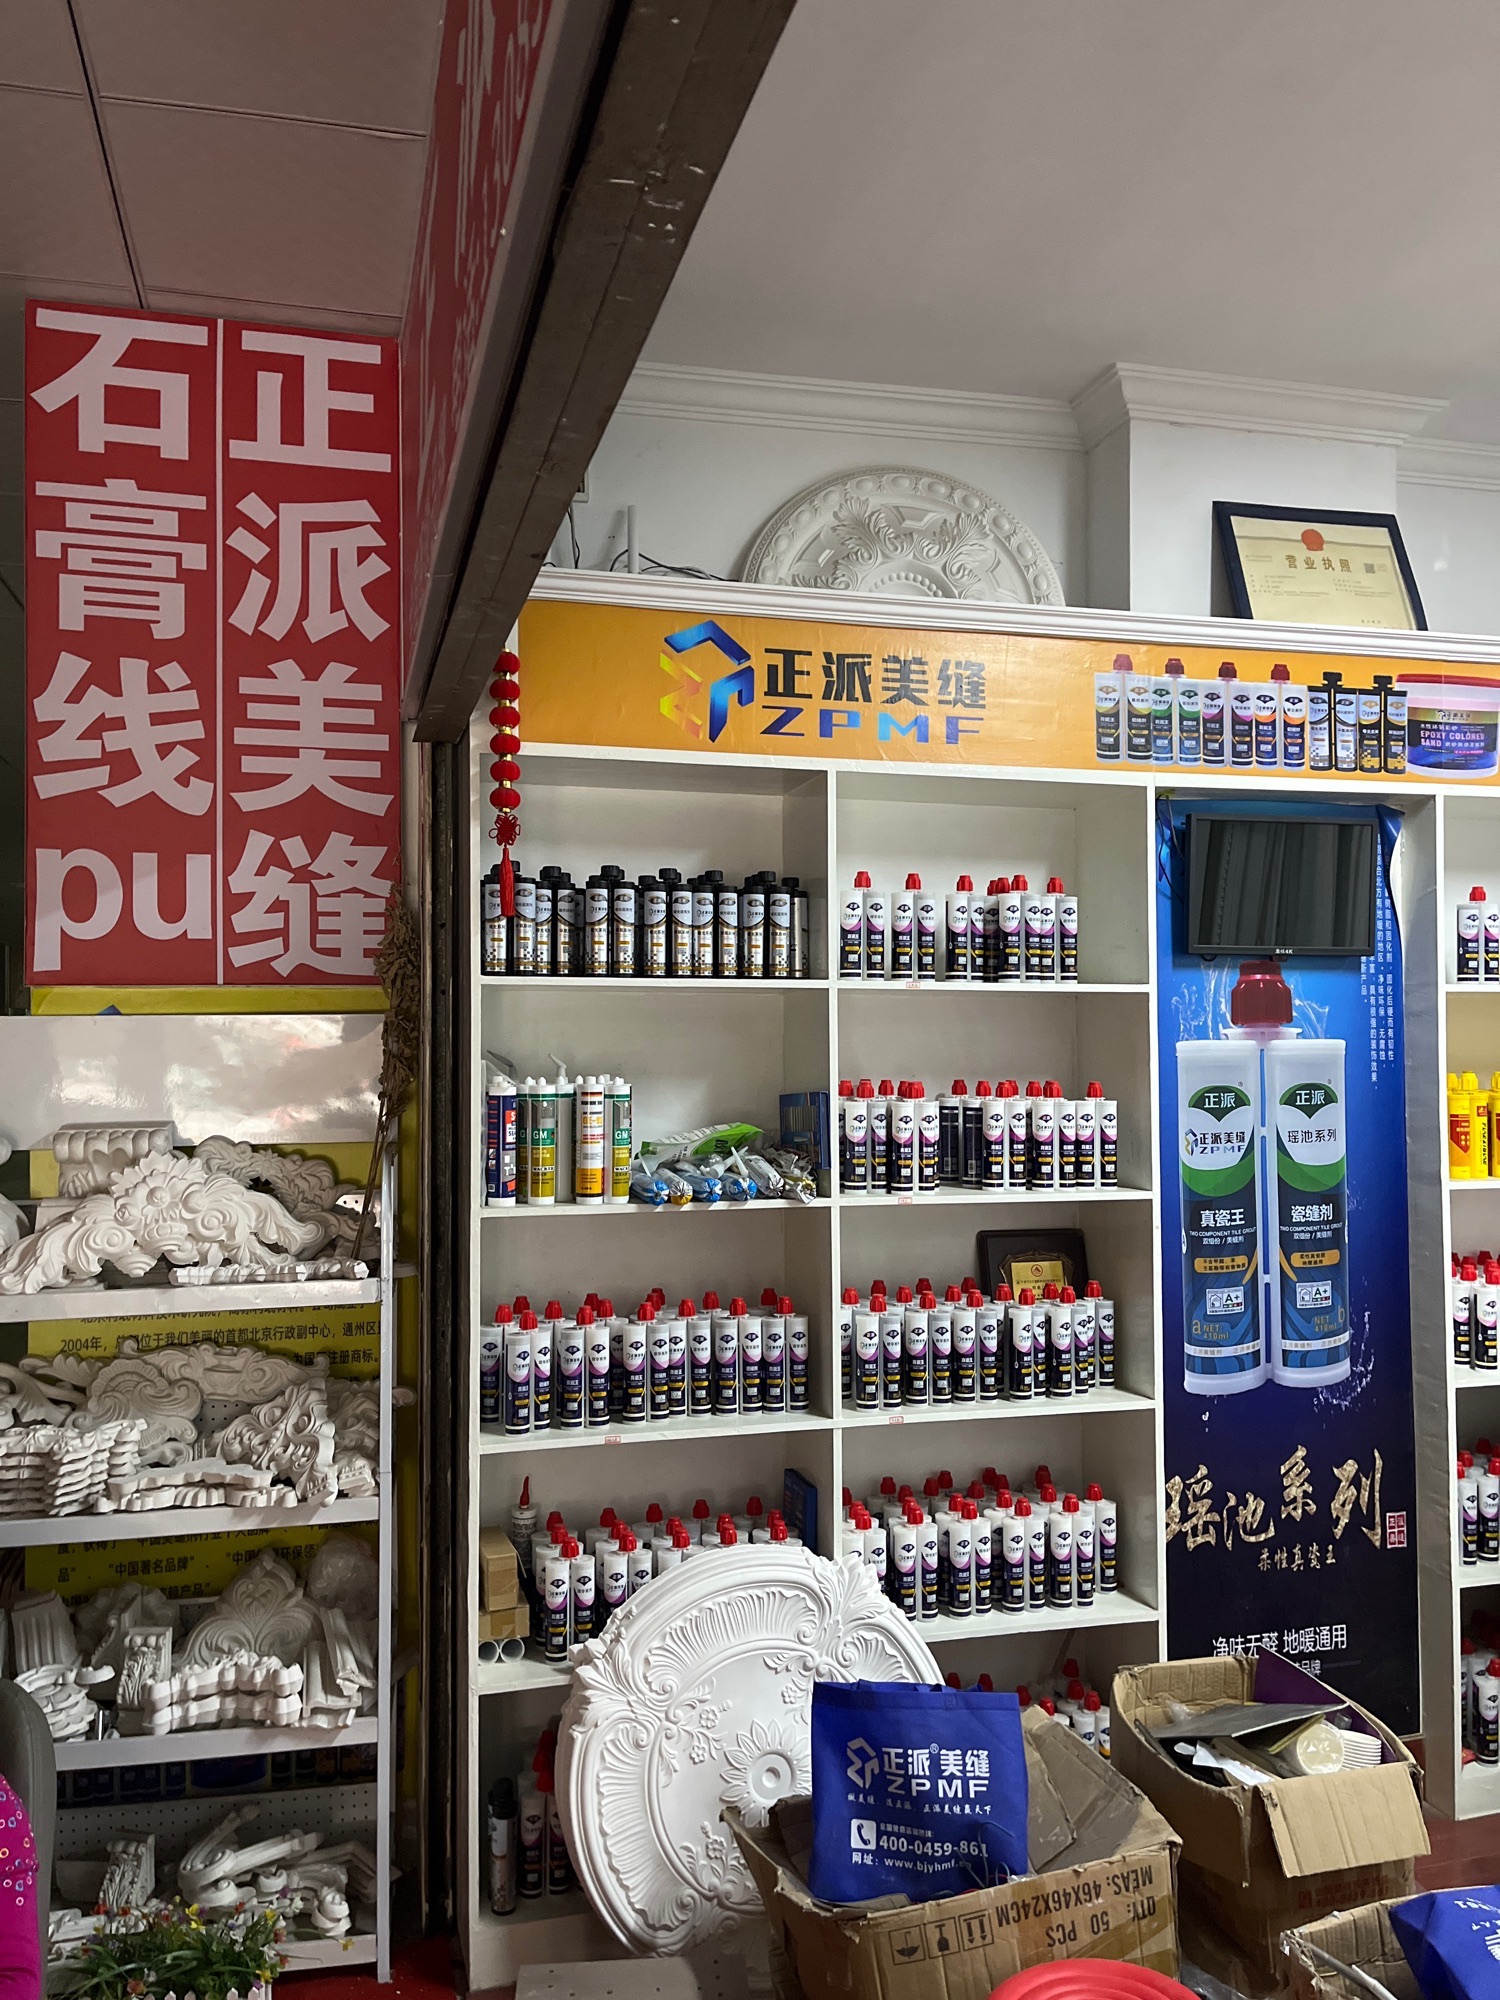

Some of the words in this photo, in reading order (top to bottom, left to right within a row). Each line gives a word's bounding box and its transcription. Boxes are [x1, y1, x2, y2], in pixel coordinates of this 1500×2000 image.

[1285, 554, 1352, 573] 营业执照
[225, 329, 395, 978] 正派美缝
[763, 647, 987, 709] 正派美缝
[759, 704, 985, 744] ZPMF
[1420, 730, 1446, 740] EPOXY
[1449, 732, 1485, 740] COLORED
[1420, 738, 1442, 747] SAND
[1204, 1092, 1236, 1108] 正派
[1295, 1089, 1325, 1106] 正派
[533, 1130, 548, 1139] GM
[1200, 1131, 1246, 1145] 正派美缝
[1287, 1128, 1337, 1144] 瑶池系列
[1200, 1145, 1246, 1155] ZPMF
[1200, 1208, 1246, 1228] 真瓷王
[1291, 1203, 1334, 1223] 瓷缝剂
[1225, 1294, 1240, 1303] A+
[1314, 1287, 1329, 1297] A+
[1192, 1319, 1202, 1335] a
[1203, 1331, 1230, 1340] 410ml
[293, 1349, 379, 1367] 为国注册商标。
[1166, 1445, 1383, 1551] 瑶池系列
[1283, 1624, 1347, 1654] 地暖通用
[886, 1775, 989, 1799] ZPMF
[1106, 1864, 1153, 1896] MEAS:
[1127, 1895, 1156, 1922] QTY:
[1090, 1911, 1110, 1936] 50
[1046, 1923, 1078, 1948] PCS
